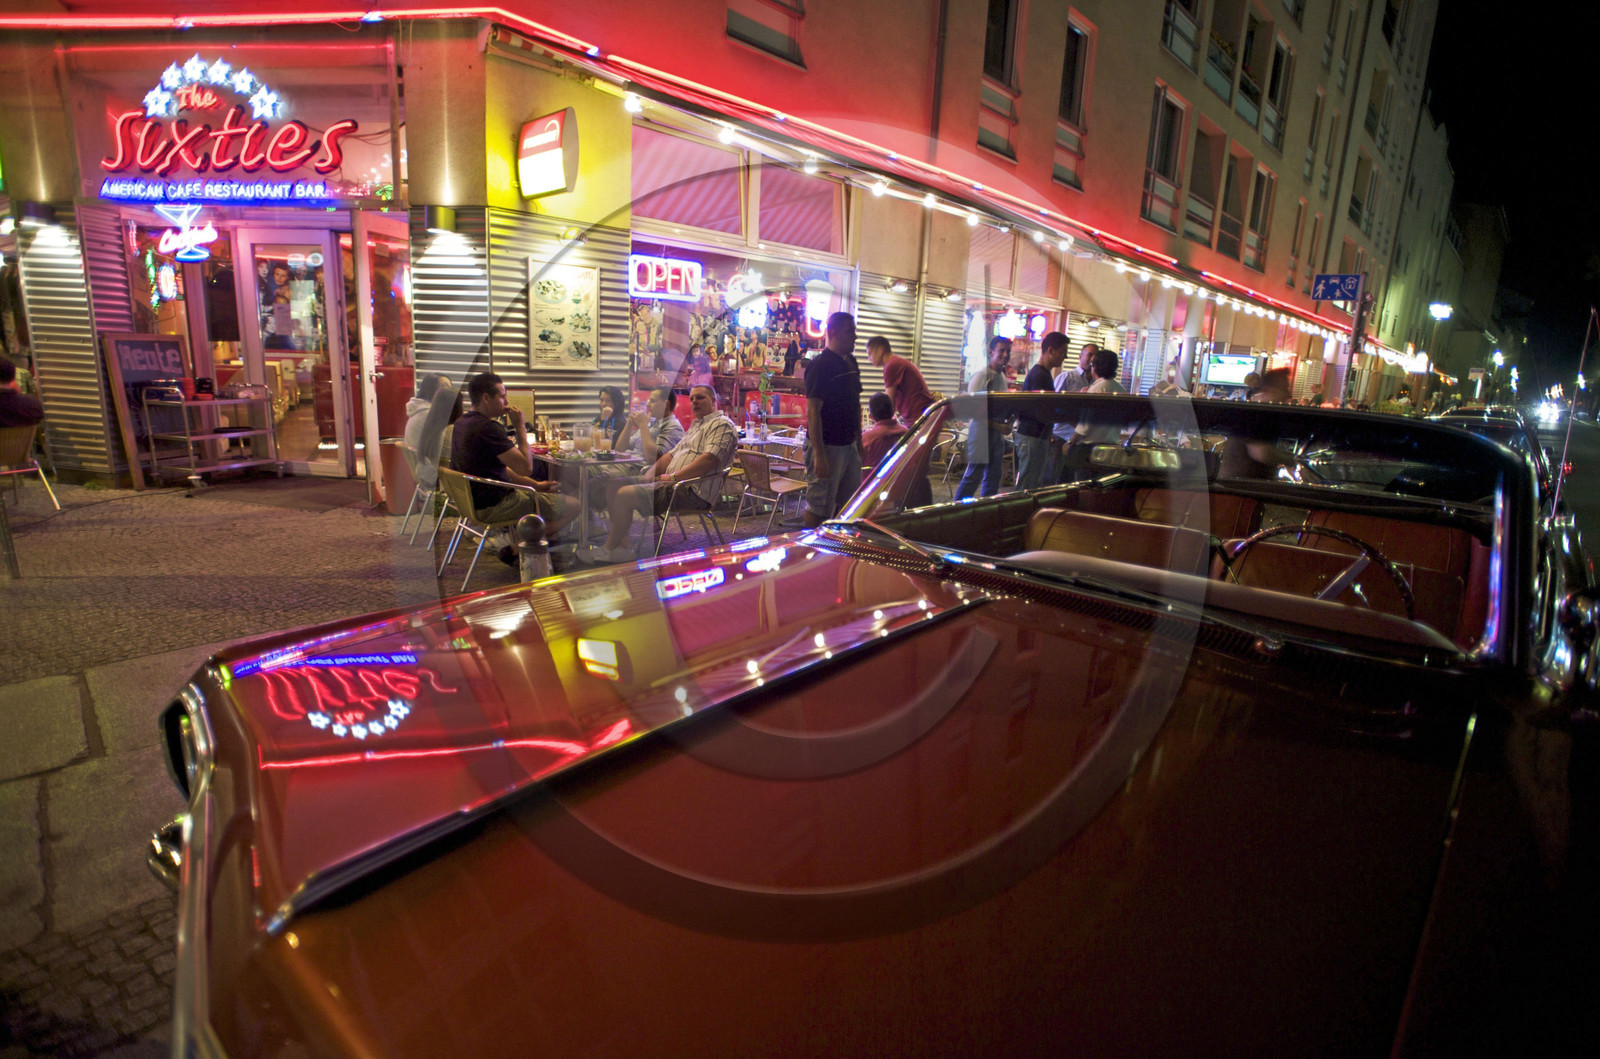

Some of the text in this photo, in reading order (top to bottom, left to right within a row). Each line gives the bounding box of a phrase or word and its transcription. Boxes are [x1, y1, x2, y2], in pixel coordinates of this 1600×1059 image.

[174, 82, 219, 110] The
[101, 104, 358, 177] Sixties
[100, 181, 327, 198] AMERICAN CAFE RESTAURANT BAR
[634, 258, 699, 296] OPEN
[117, 342, 183, 374] Heute
